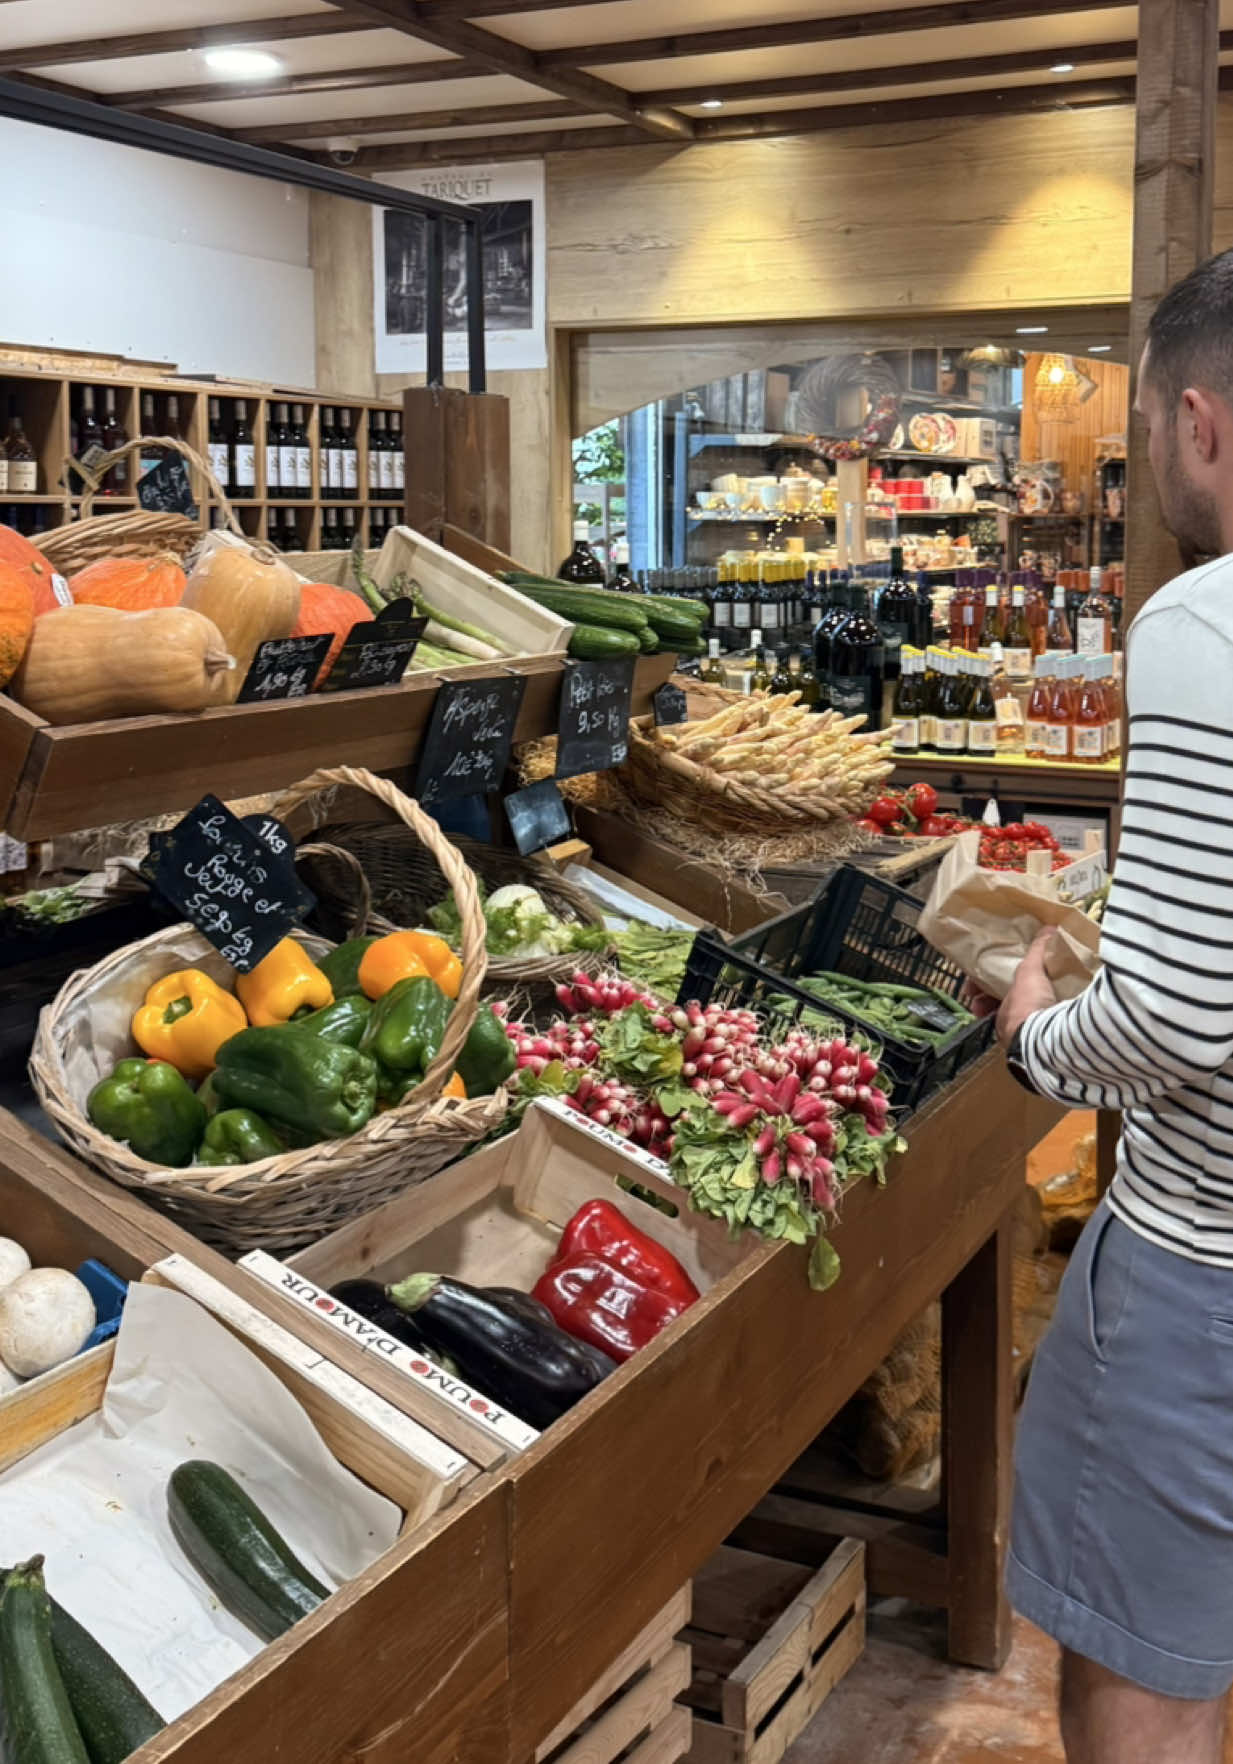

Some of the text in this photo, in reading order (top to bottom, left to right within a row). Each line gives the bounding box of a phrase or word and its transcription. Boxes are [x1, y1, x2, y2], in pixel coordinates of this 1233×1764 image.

[258, 820, 288, 854] 1kg
[207, 854, 283, 914] Rouge et
